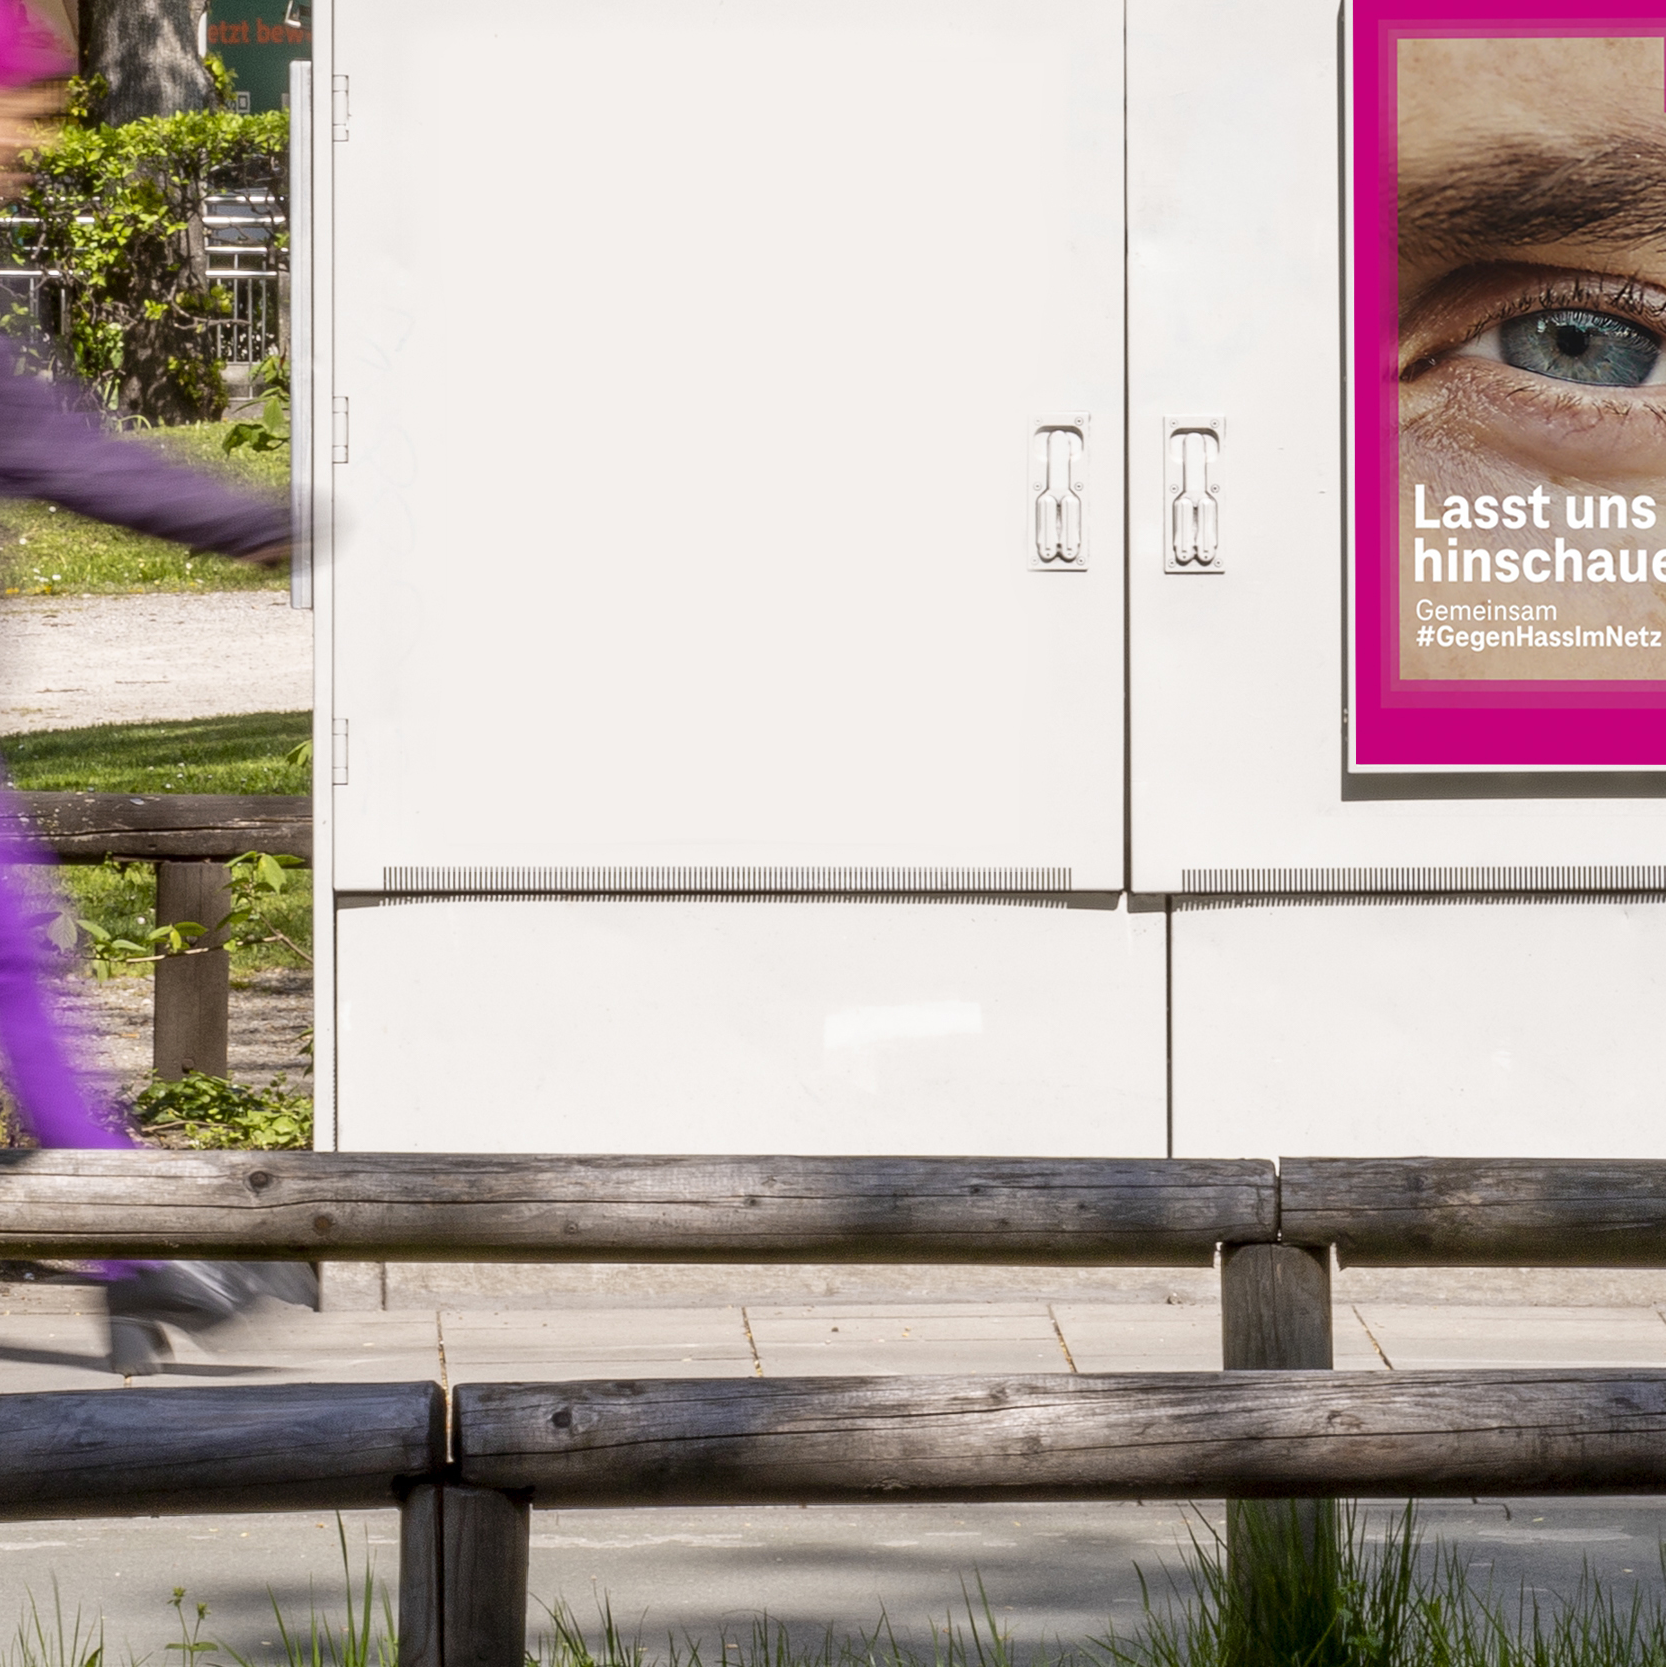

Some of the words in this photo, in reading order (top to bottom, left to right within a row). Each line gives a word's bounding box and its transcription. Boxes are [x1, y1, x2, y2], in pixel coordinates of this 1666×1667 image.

[208, 20, 250, 45] etzt
[1414, 484, 1550, 529] Lasst
[1566, 495, 1657, 529] uns
[1416, 599, 1557, 621] Gemeinsam
[1416, 625, 1662, 651] #GegenHassImNetz
